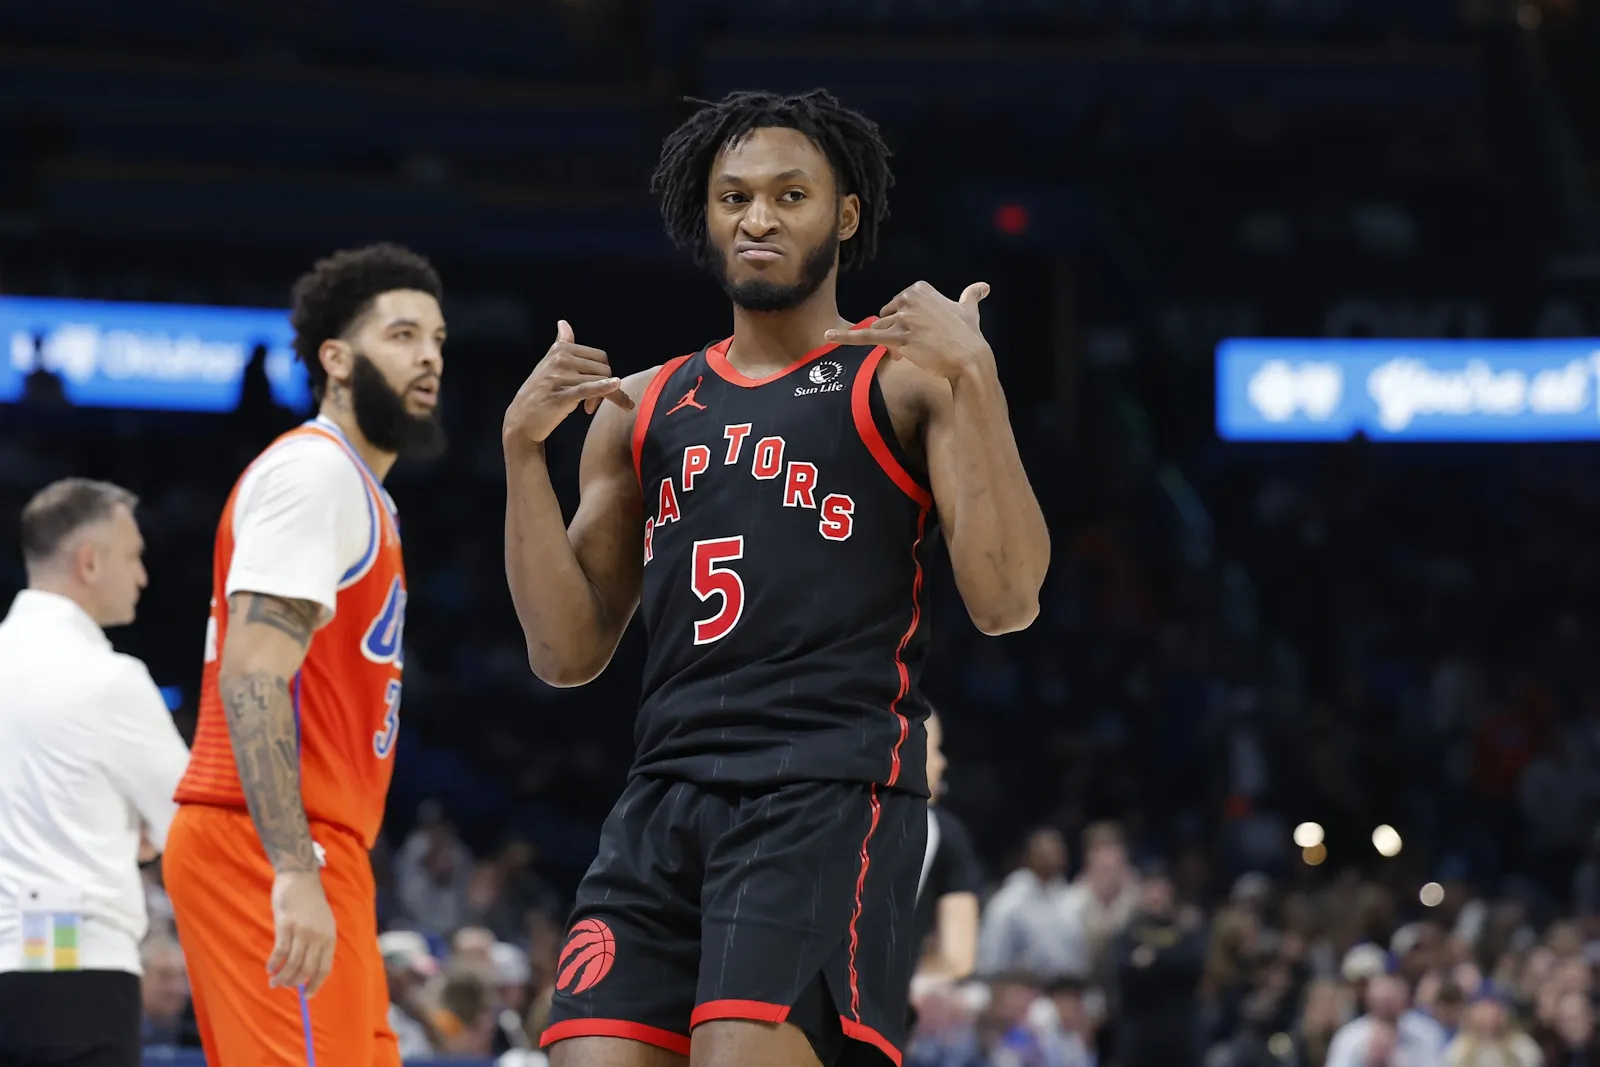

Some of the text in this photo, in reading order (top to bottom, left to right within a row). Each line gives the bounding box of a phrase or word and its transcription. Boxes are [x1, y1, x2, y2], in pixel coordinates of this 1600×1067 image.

[794, 381, 843, 397] Sun Life
[643, 422, 855, 566] RAPTORS
[691, 534, 745, 645] 5
